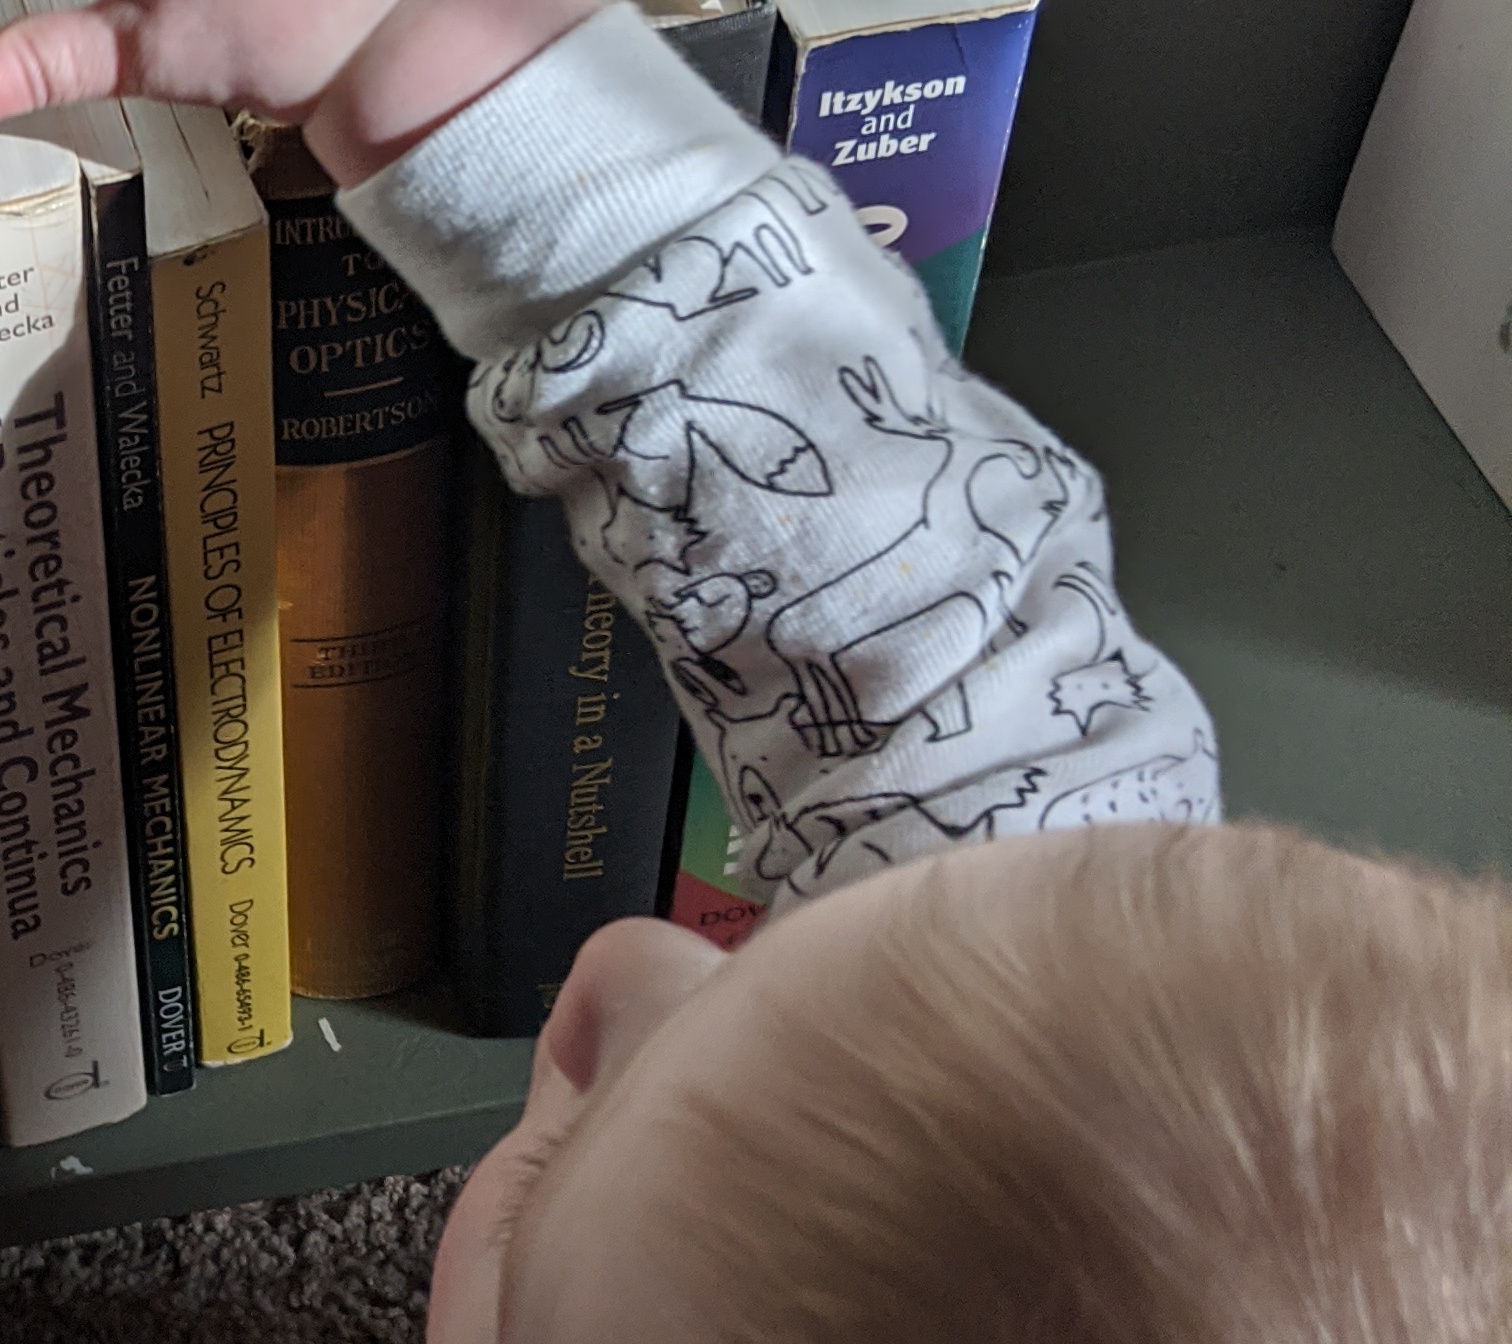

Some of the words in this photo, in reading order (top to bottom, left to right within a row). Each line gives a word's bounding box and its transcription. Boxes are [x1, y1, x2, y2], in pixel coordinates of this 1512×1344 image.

[819, 74, 967, 118] Itzykson
[860, 103, 916, 135] and
[831, 131, 937, 167] Zuber
[105, 257, 140, 342] Fetter
[195, 280, 228, 400] Schwartz
[112, 350, 146, 399] and
[287, 318, 432, 375] OPTICS
[117, 402, 154, 513] Walecka
[14, 390, 88, 677] Theoretical
[196, 419, 242, 582] PRINCIPLES
[204, 582, 244, 622] OF
[568, 574, 618, 682] heory
[128, 574, 169, 766] NONLINEAR
[575, 688, 622, 727] in
[207, 627, 256, 876] ELECTRODYNAMICS
[572, 735, 604, 755] a
[41, 681, 103, 898] Mechanics
[562, 755, 615, 883] Nutshell
[142, 773, 180, 942] MECHANICS
[229, 898, 255, 950] Dover
[157, 985, 189, 1057] DOVER
